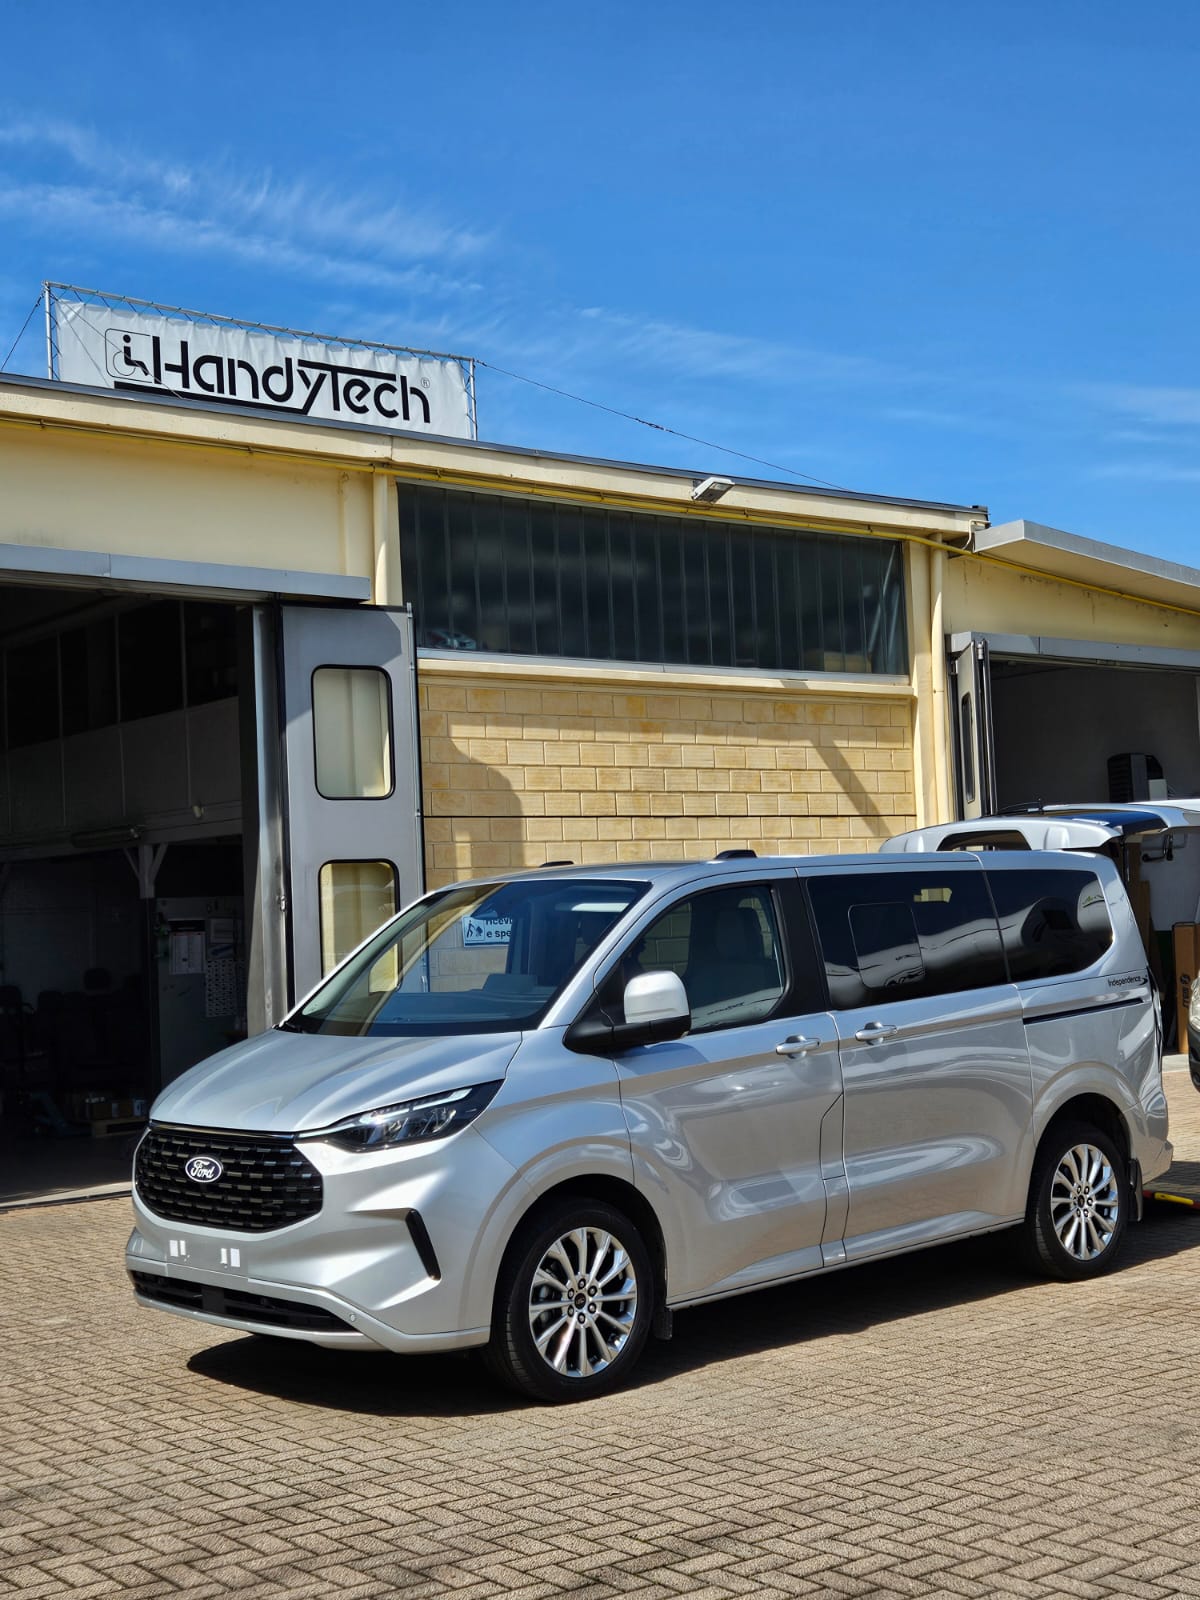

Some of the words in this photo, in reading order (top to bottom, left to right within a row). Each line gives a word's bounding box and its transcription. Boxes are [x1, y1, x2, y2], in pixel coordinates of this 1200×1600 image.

[152, 335, 431, 424] HandyTech
[1107, 976, 1141, 987] Independence
[190, 1159, 216, 1179] Ford
